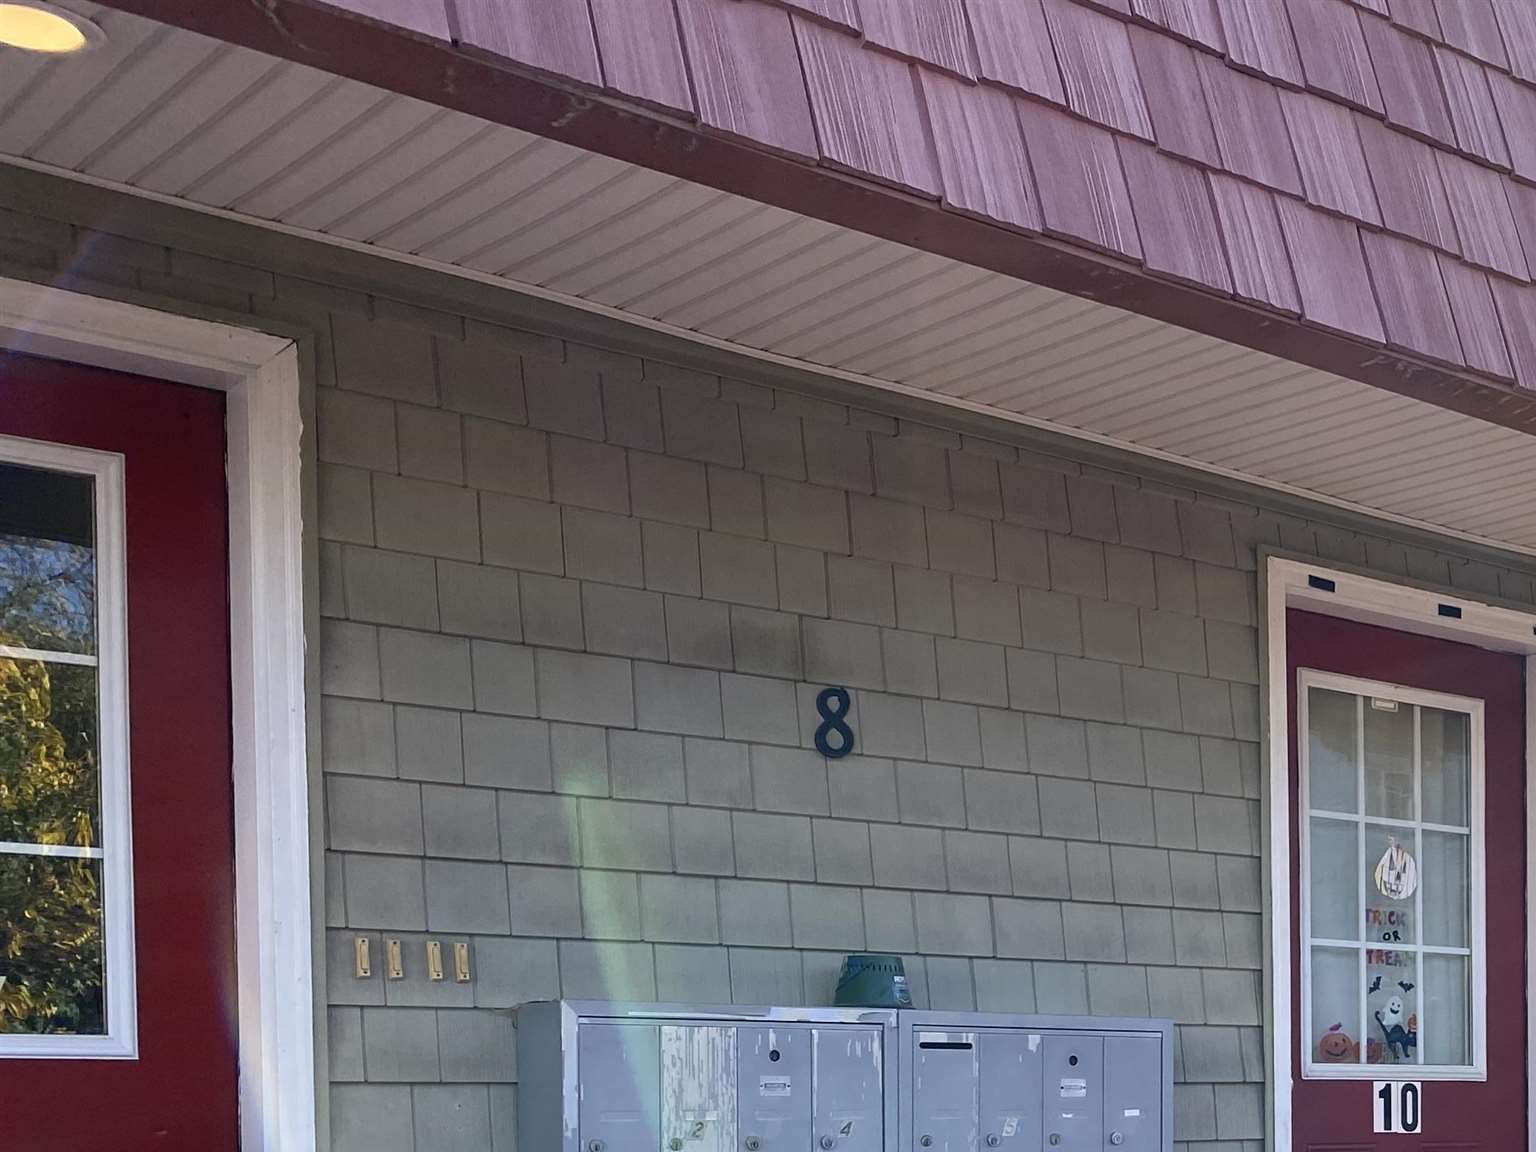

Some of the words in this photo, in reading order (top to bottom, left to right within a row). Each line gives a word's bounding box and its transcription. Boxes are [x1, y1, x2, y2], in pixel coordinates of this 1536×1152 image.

[815, 687, 854, 759] 8
[1365, 908, 1406, 926] TRICK
[1382, 930, 1401, 941] OR
[1378, 1083, 1418, 1132] 10
[691, 1121, 704, 1138] 2
[839, 1120, 853, 1137] 4
